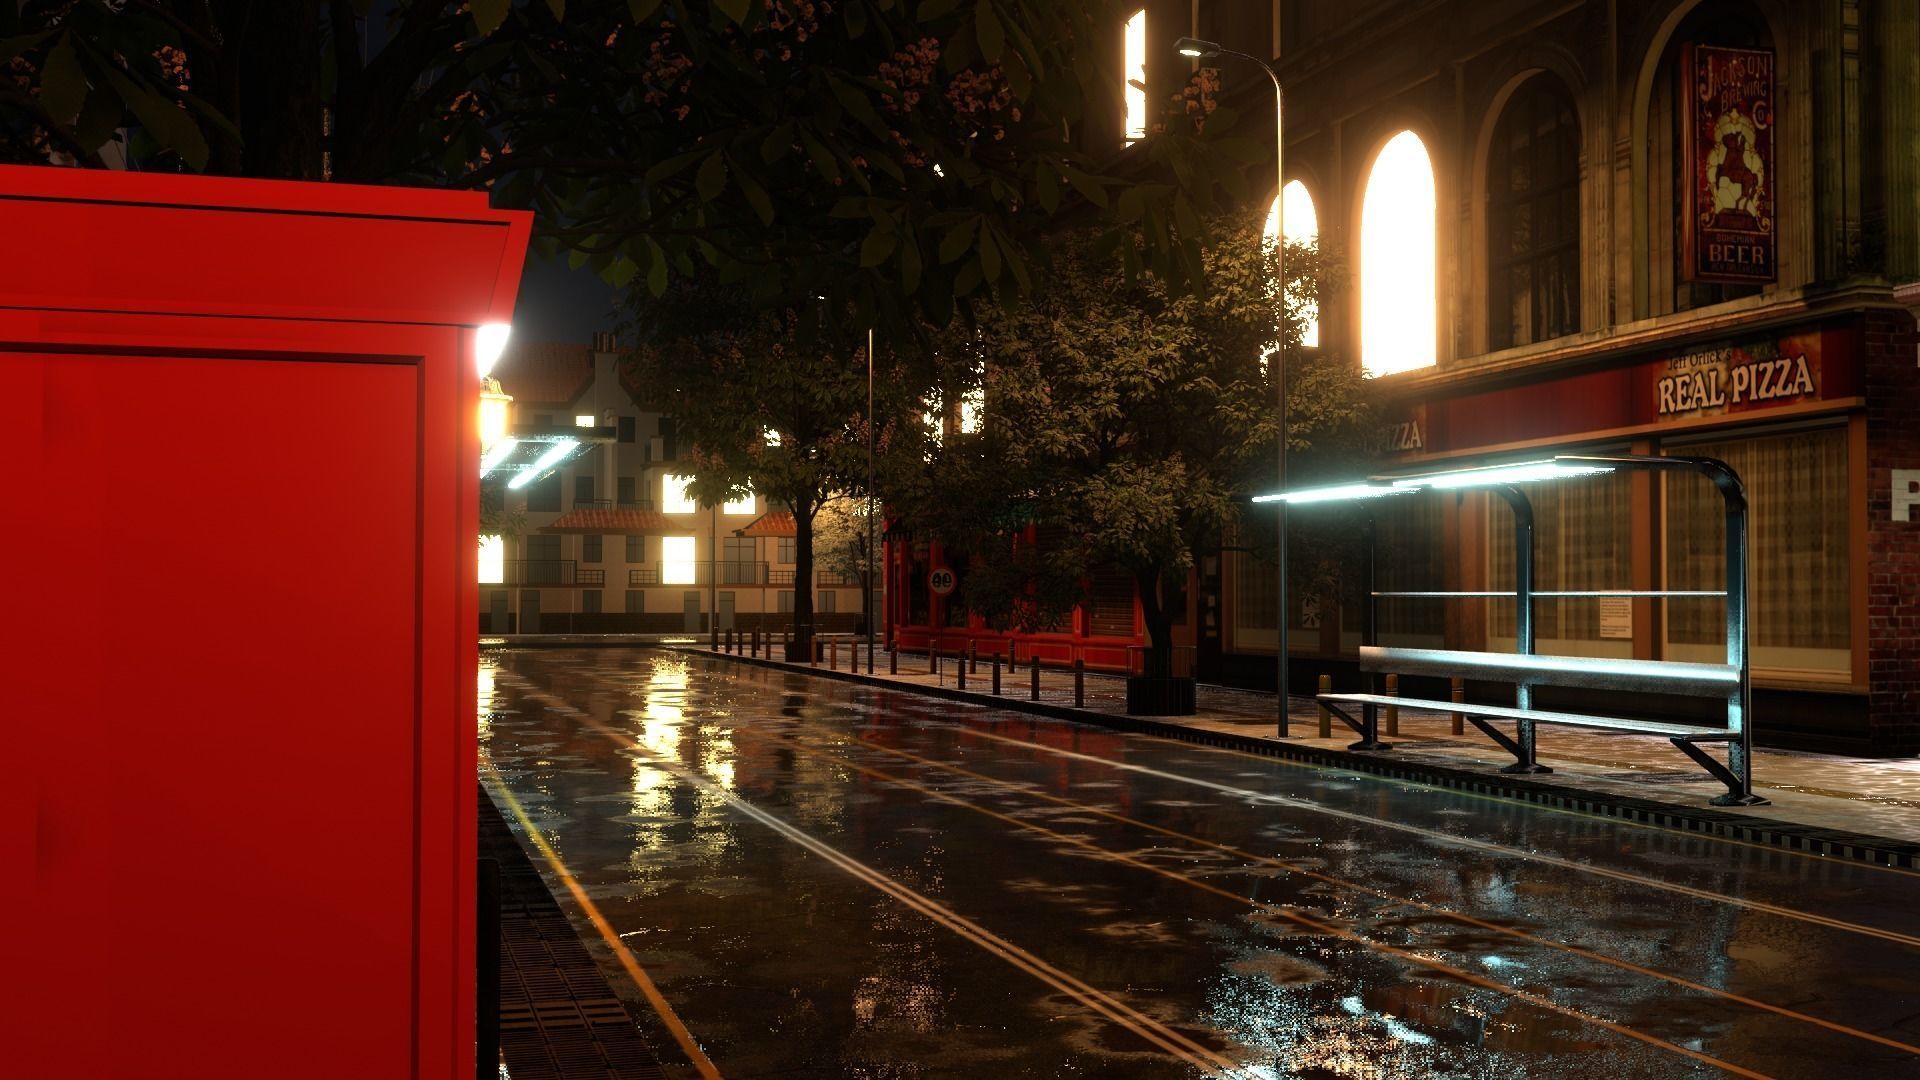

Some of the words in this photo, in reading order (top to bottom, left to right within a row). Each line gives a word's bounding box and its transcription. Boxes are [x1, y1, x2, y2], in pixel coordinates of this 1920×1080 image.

[1709, 244, 1764, 265] BEER
[1668, 353, 1688, 370] Jeff
[1658, 370, 1726, 414] REAL
[1731, 353, 1815, 404] PIZZA
